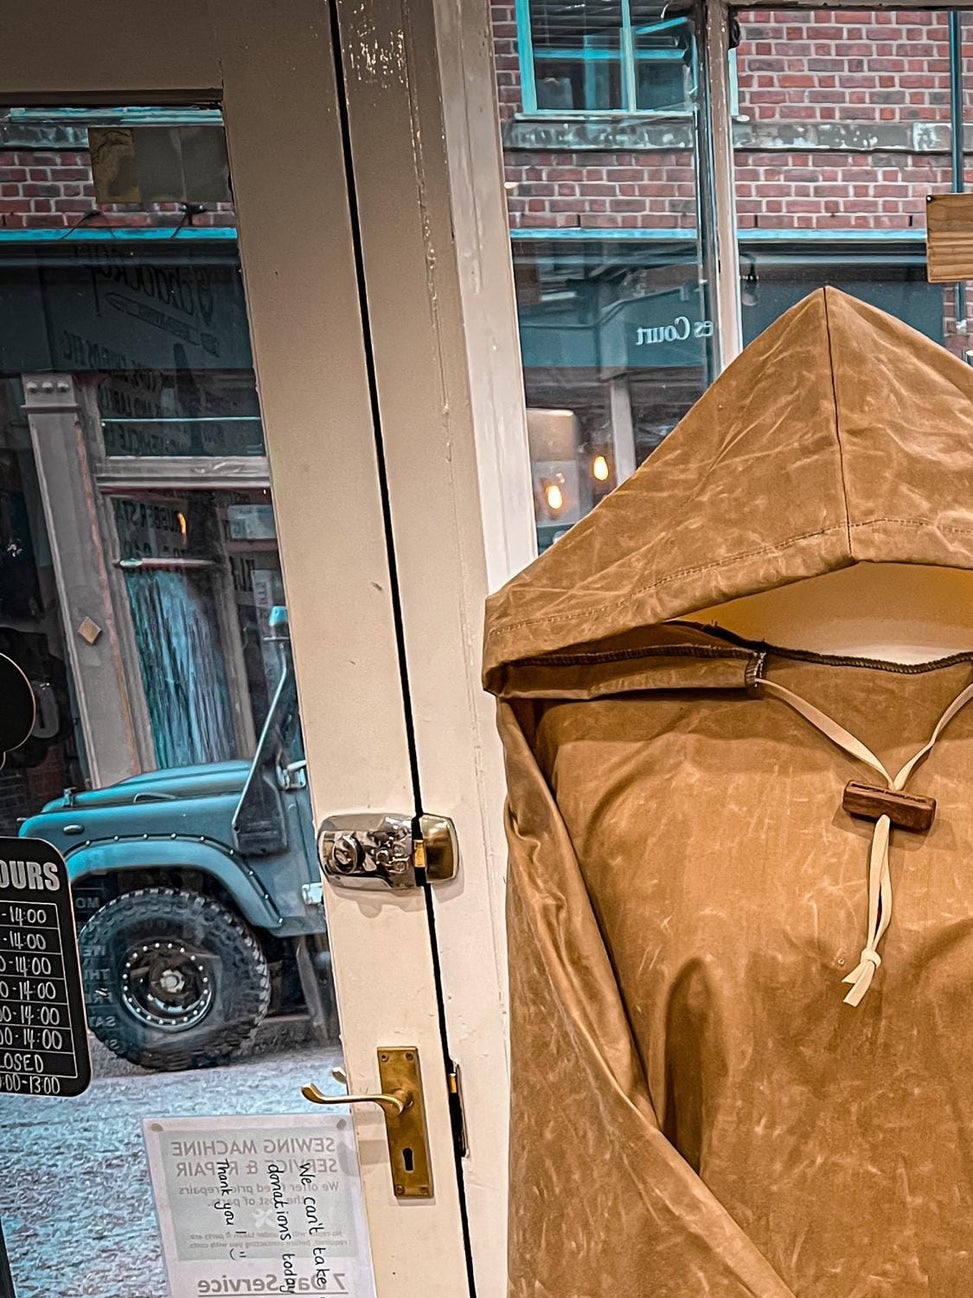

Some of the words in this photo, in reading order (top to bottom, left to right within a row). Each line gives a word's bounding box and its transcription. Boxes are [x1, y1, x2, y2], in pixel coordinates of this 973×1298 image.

[216, 1157, 234, 1197] Thank
[299, 1162, 317, 1186] We
[267, 1164, 292, 1242] donations
[303, 1196, 325, 1236] can't
[313, 1247, 330, 1288] take
